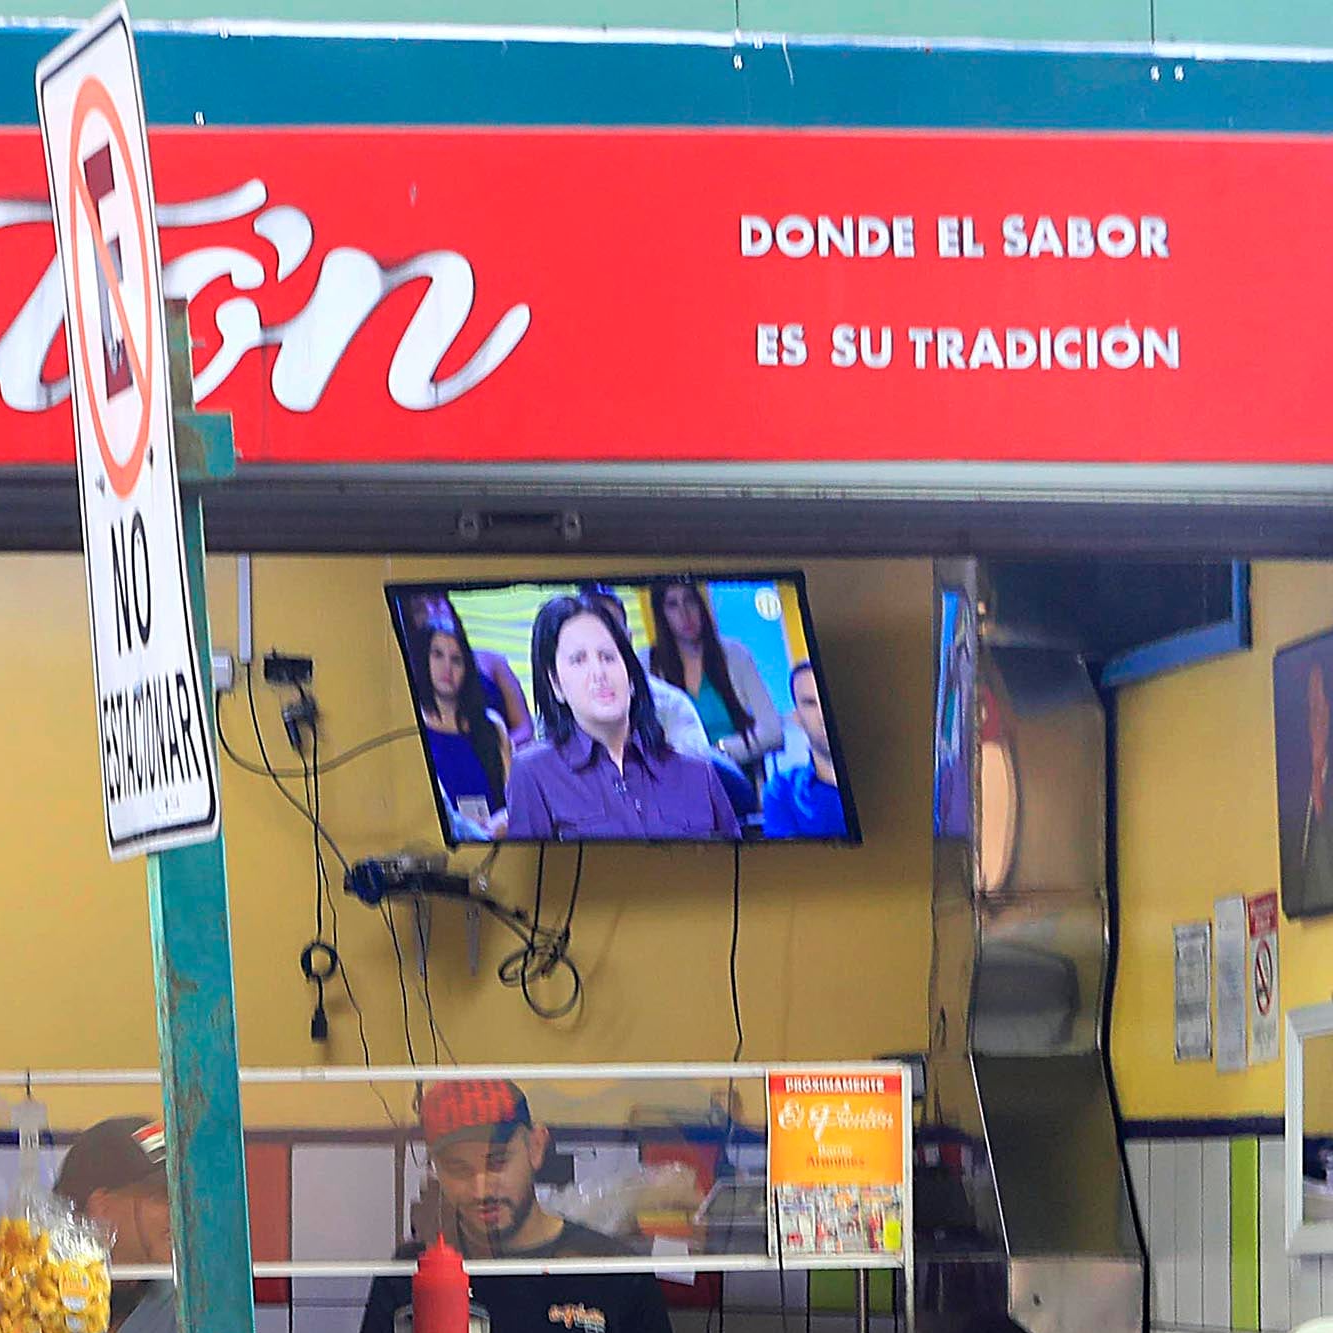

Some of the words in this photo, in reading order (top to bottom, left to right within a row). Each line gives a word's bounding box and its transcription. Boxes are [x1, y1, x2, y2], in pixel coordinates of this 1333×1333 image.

[739, 214, 916, 259] DONDE
[937, 214, 985, 259] EL
[1002, 214, 1171, 259] SABOR
[756, 322, 808, 367] ES
[831, 322, 892, 368] SU
[908, 318, 1181, 370] TRADICIÓN
[109, 509, 152, 660] NO
[101, 670, 203, 804] ESTACIONAR
